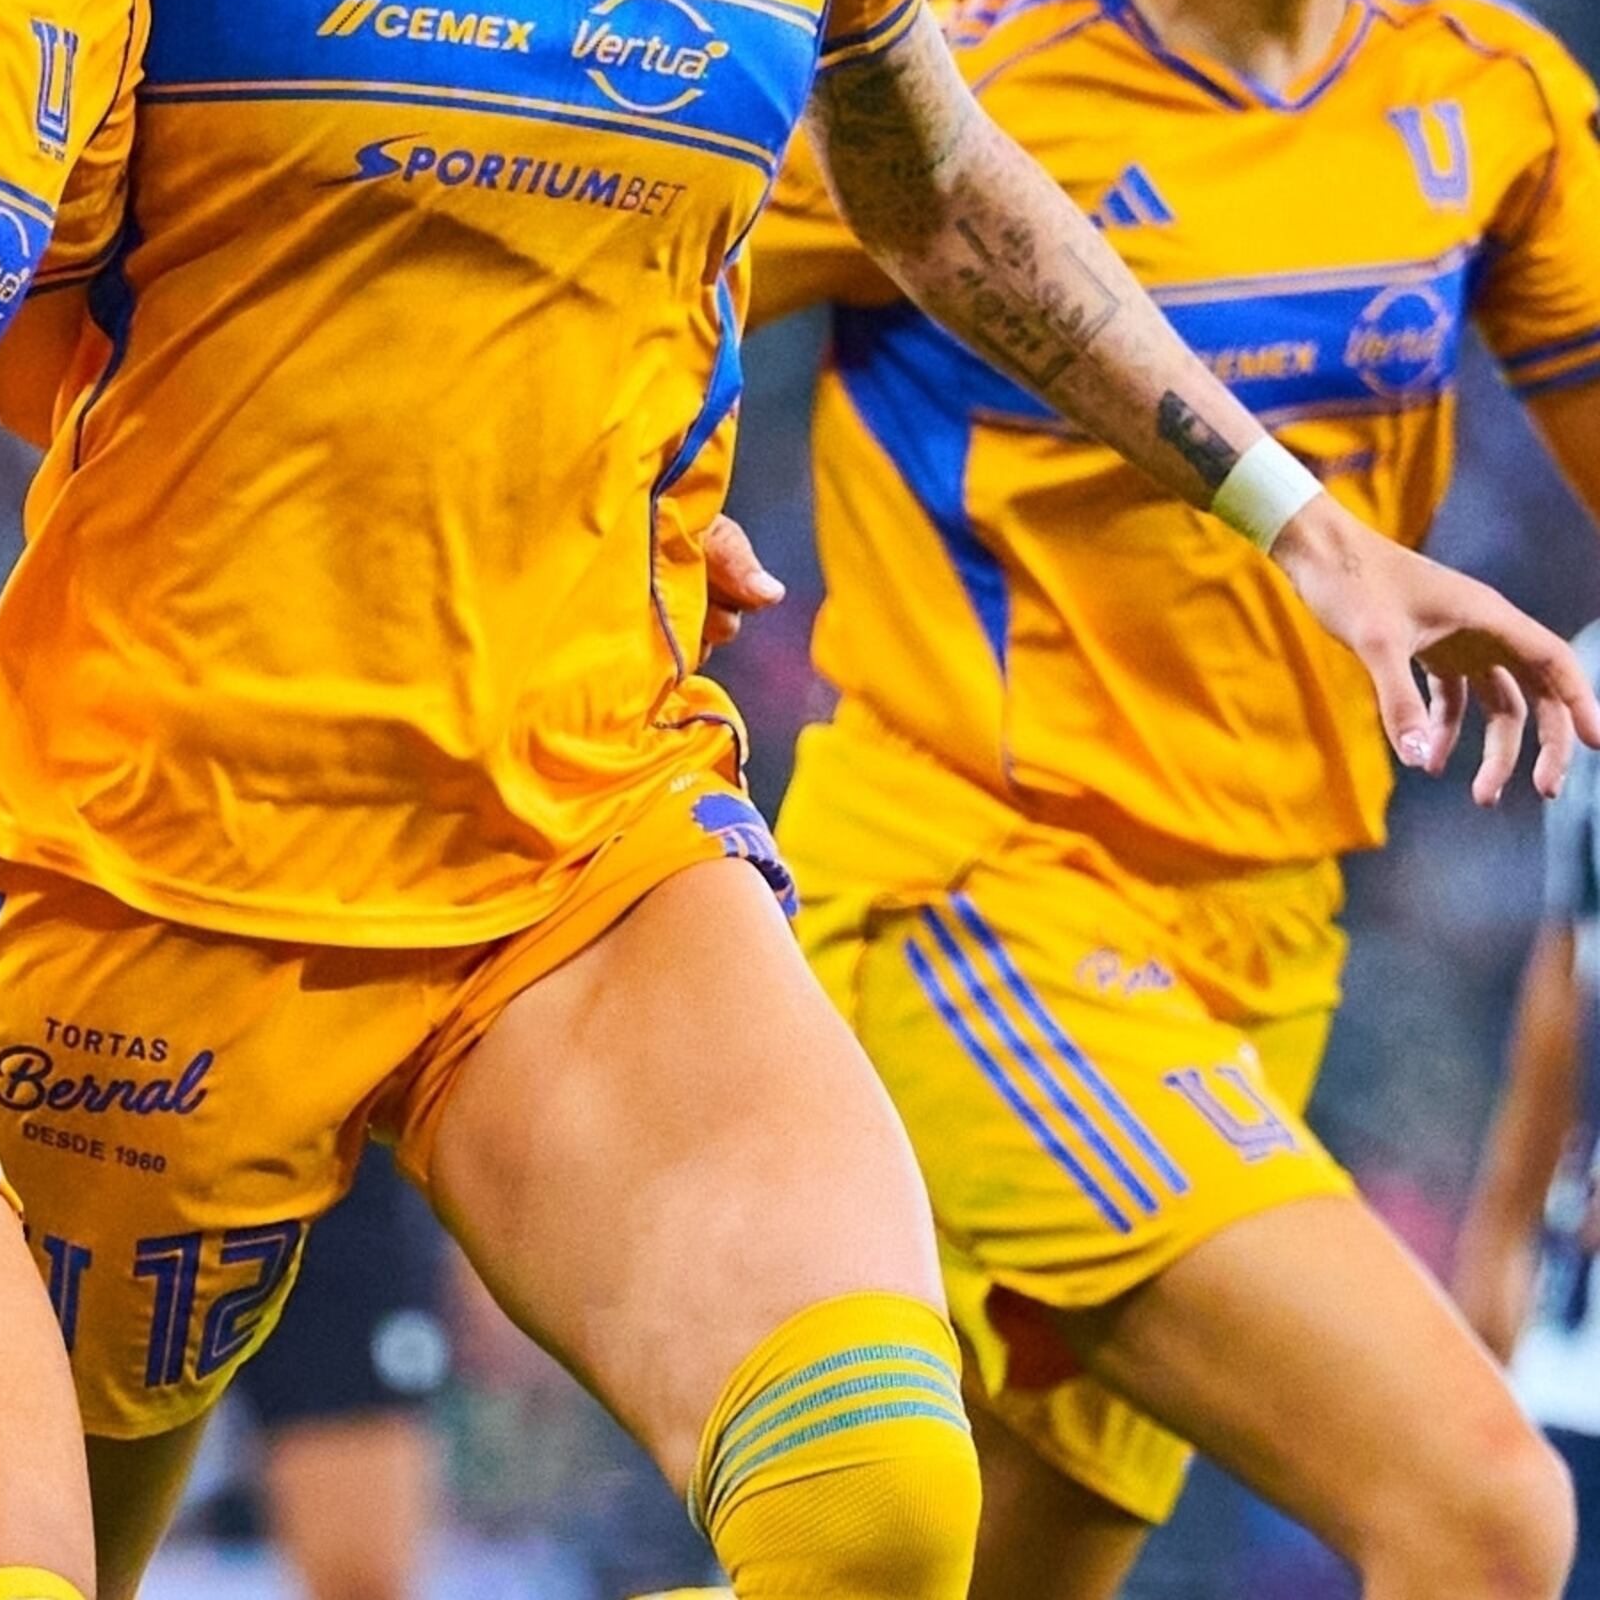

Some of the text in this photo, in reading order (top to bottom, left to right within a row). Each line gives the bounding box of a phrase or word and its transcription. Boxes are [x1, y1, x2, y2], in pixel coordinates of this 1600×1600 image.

[374, 4, 712, 80] CEMEX Vertua
[30, 17, 78, 144] U
[45, 1017, 169, 1063] TORTAS
[21, 1121, 167, 1173] DESDE 1960
[133, 1219, 301, 1389] 12
